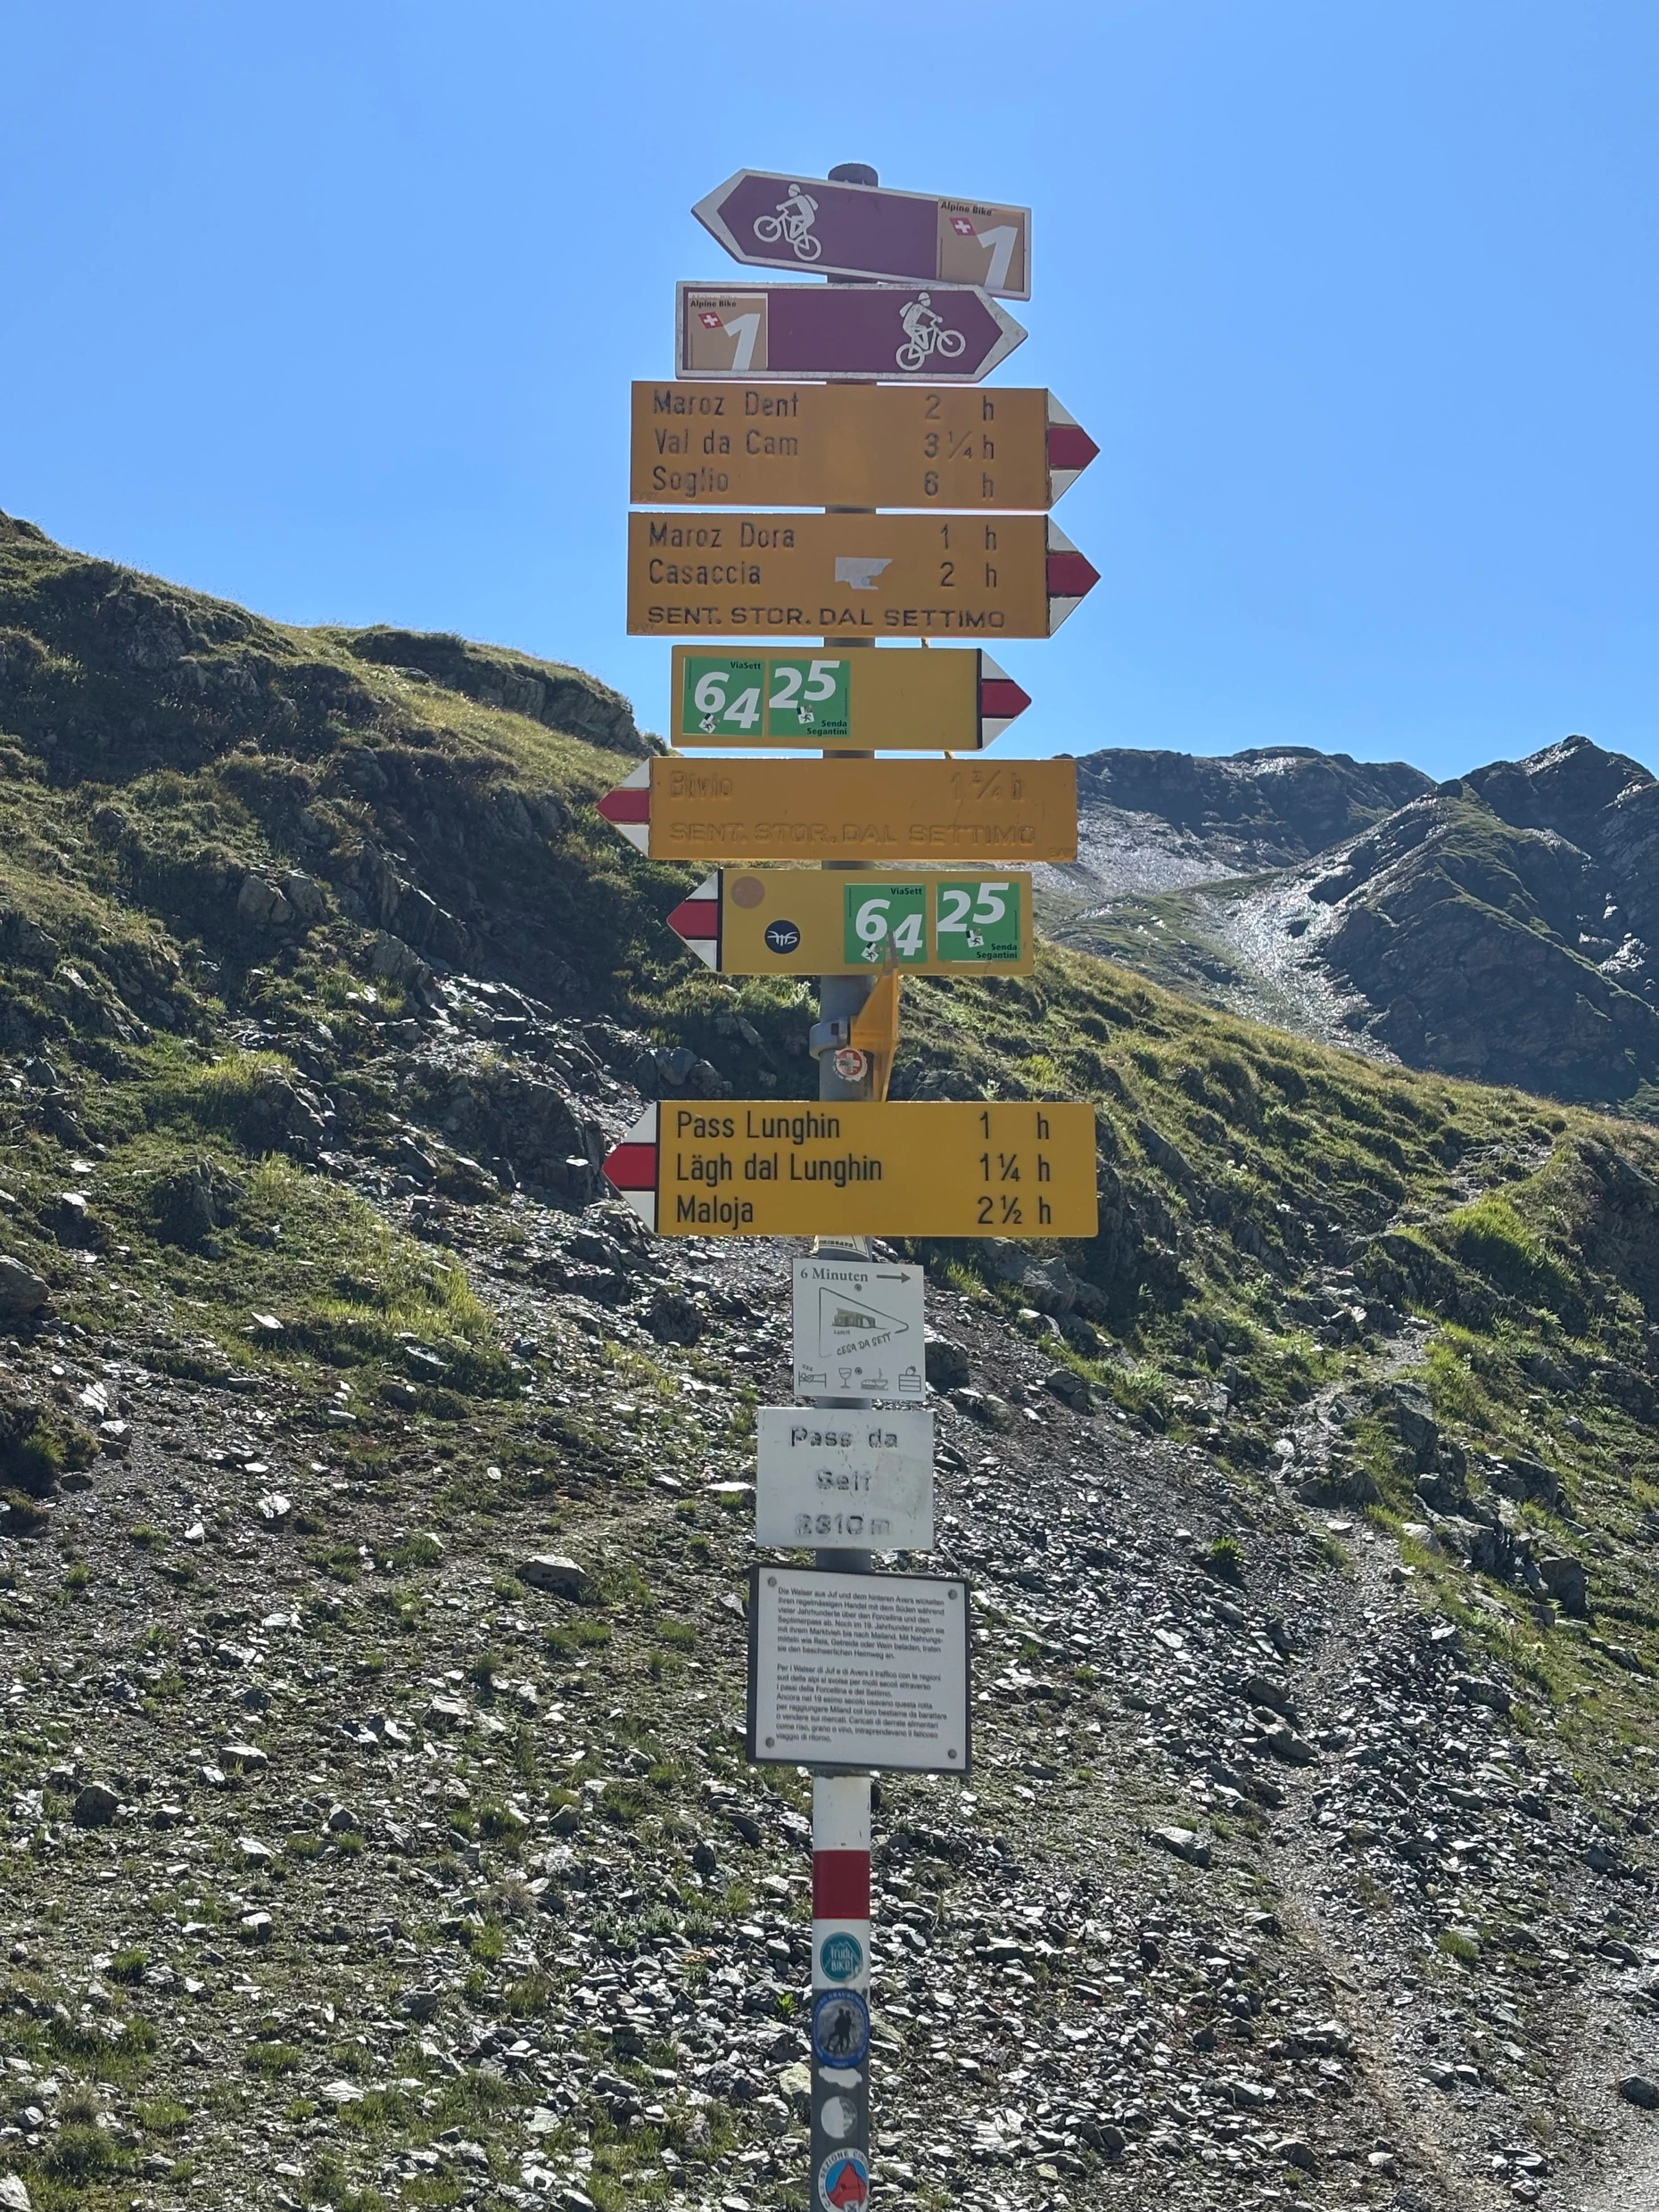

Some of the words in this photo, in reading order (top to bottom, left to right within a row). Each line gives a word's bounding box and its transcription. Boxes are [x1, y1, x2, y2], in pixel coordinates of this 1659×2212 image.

[941, 202, 970, 213] Alpine
[972, 204, 992, 216] Bike
[977, 225, 1019, 290] 1
[690, 300, 717, 309] Alpine
[723, 313, 761, 371] 1
[653, 389, 724, 416] Maroz
[745, 391, 798, 417] Dent
[925, 394, 940, 420] 2
[983, 395, 994, 421] h
[655, 428, 689, 455] Val
[703, 429, 730, 455] da
[746, 428, 798, 456] Cam
[983, 433, 994, 460] h
[652, 466, 729, 498] Soglio
[924, 470, 938, 497] 6
[982, 472, 994, 498] h
[649, 521, 722, 548] Maroz
[740, 521, 795, 549] Dora
[940, 524, 949, 549] 1
[985, 524, 997, 550] h
[649, 558, 761, 585] Casaccia
[940, 561, 955, 587] 2
[986, 562, 997, 588] h
[648, 607, 722, 624] SENT.
[730, 607, 812, 625] STOR.
[819, 607, 874, 626] DAL
[884, 609, 1005, 629] SETTIMO
[730, 661, 761, 670] ViaSett
[769, 660, 840, 709] 25
[694, 671, 761, 729] 64
[806, 728, 847, 737] Segantini
[821, 720, 847, 728] Senda
[670, 771, 733, 798] Bivio
[1011, 772, 1024, 801] h
[669, 822, 749, 842] SENT.
[842, 824, 897, 844] DAL
[908, 824, 1036, 846] SETTIMO
[890, 887, 922, 896] ViaSett
[937, 882, 1010, 932] 25
[855, 899, 923, 956] 64
[976, 951, 1018, 960] Segantini
[677, 1110, 735, 1139] Pass
[747, 1110, 840, 1145] Lunghin
[979, 1111, 988, 1140] 1
[1037, 1111, 1049, 1140] h
[676, 1152, 732, 1188] Lägh
[744, 1152, 778, 1181] dal
[790, 1152, 881, 1188] Lunghin
[1038, 1154, 1051, 1182] h
[676, 1194, 753, 1231] Maloja
[1038, 1195, 1051, 1224] h
[801, 1267, 808, 1279] 6
[812, 1267, 869, 1283] Minuten
[837, 1343, 858, 1356] CESA
[858, 1339, 871, 1349] DA
[871, 1332, 892, 1347] SETT
[790, 1427, 853, 1448] Pass
[869, 1429, 897, 1449] da
